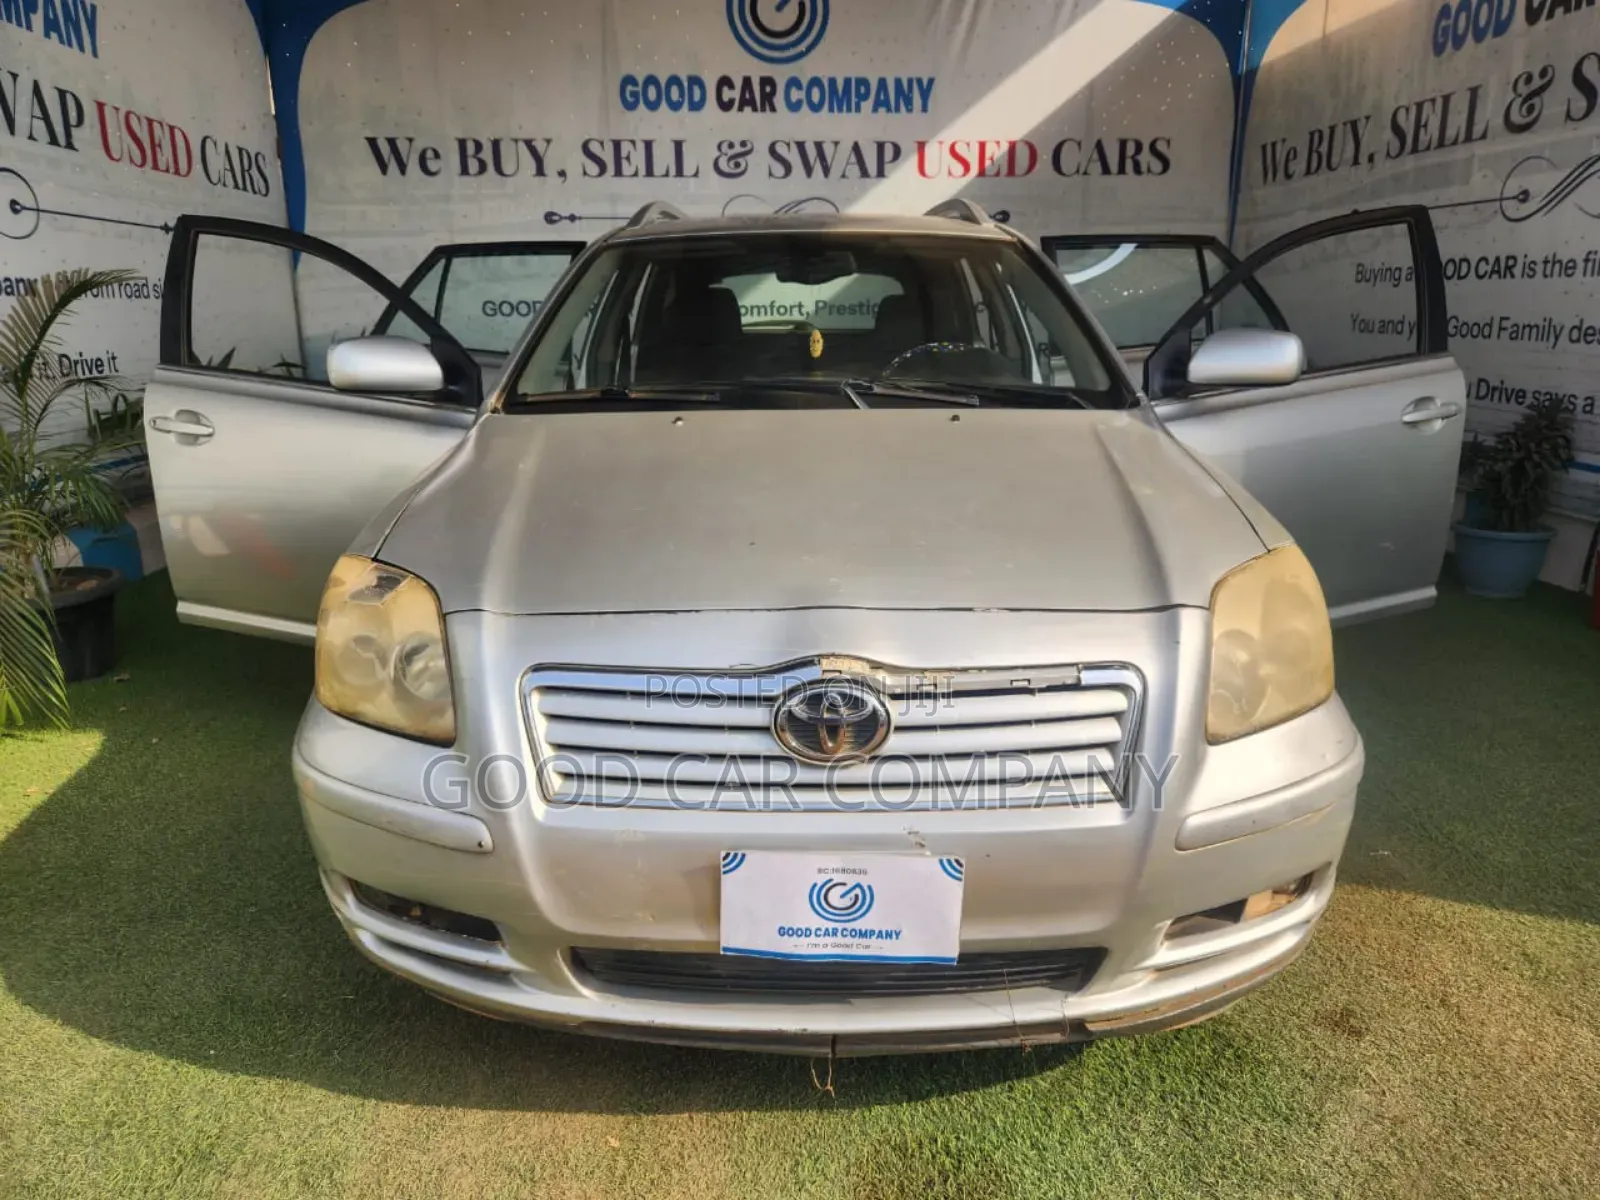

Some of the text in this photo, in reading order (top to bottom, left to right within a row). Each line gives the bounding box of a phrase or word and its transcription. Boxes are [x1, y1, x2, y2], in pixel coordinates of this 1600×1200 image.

[1433, 0, 1516, 57] GOOD
[619, 74, 935, 114] GOOD CAR COMPANY
[1260, 137, 1297, 186] We
[1304, 115, 1376, 177] BUY,
[1385, 84, 1489, 160] SELL
[1503, 64, 1555, 134] &
[94, 100, 192, 178] USED
[200, 135, 271, 197] CARS
[365, 137, 1171, 183] We BUY, SELL & SWAP USED CARS
[1355, 262, 1401, 287] Buying
[1475, 255, 1517, 280] CAR
[1521, 253, 1537, 279] is
[1542, 252, 1577, 278] the
[118, 278, 150, 299] road
[740, 299, 879, 320] omfort, Prestig
[1350, 313, 1375, 334] You
[1378, 314, 1405, 335] and
[1447, 315, 1494, 339] Good
[1497, 316, 1565, 350] Family
[57, 351, 104, 377] Drive
[107, 350, 119, 374] it
[1475, 377, 1526, 406] Drive
[1582, 395, 1595, 414] a
[778, 926, 902, 940] GOOD CAR COMPANY
